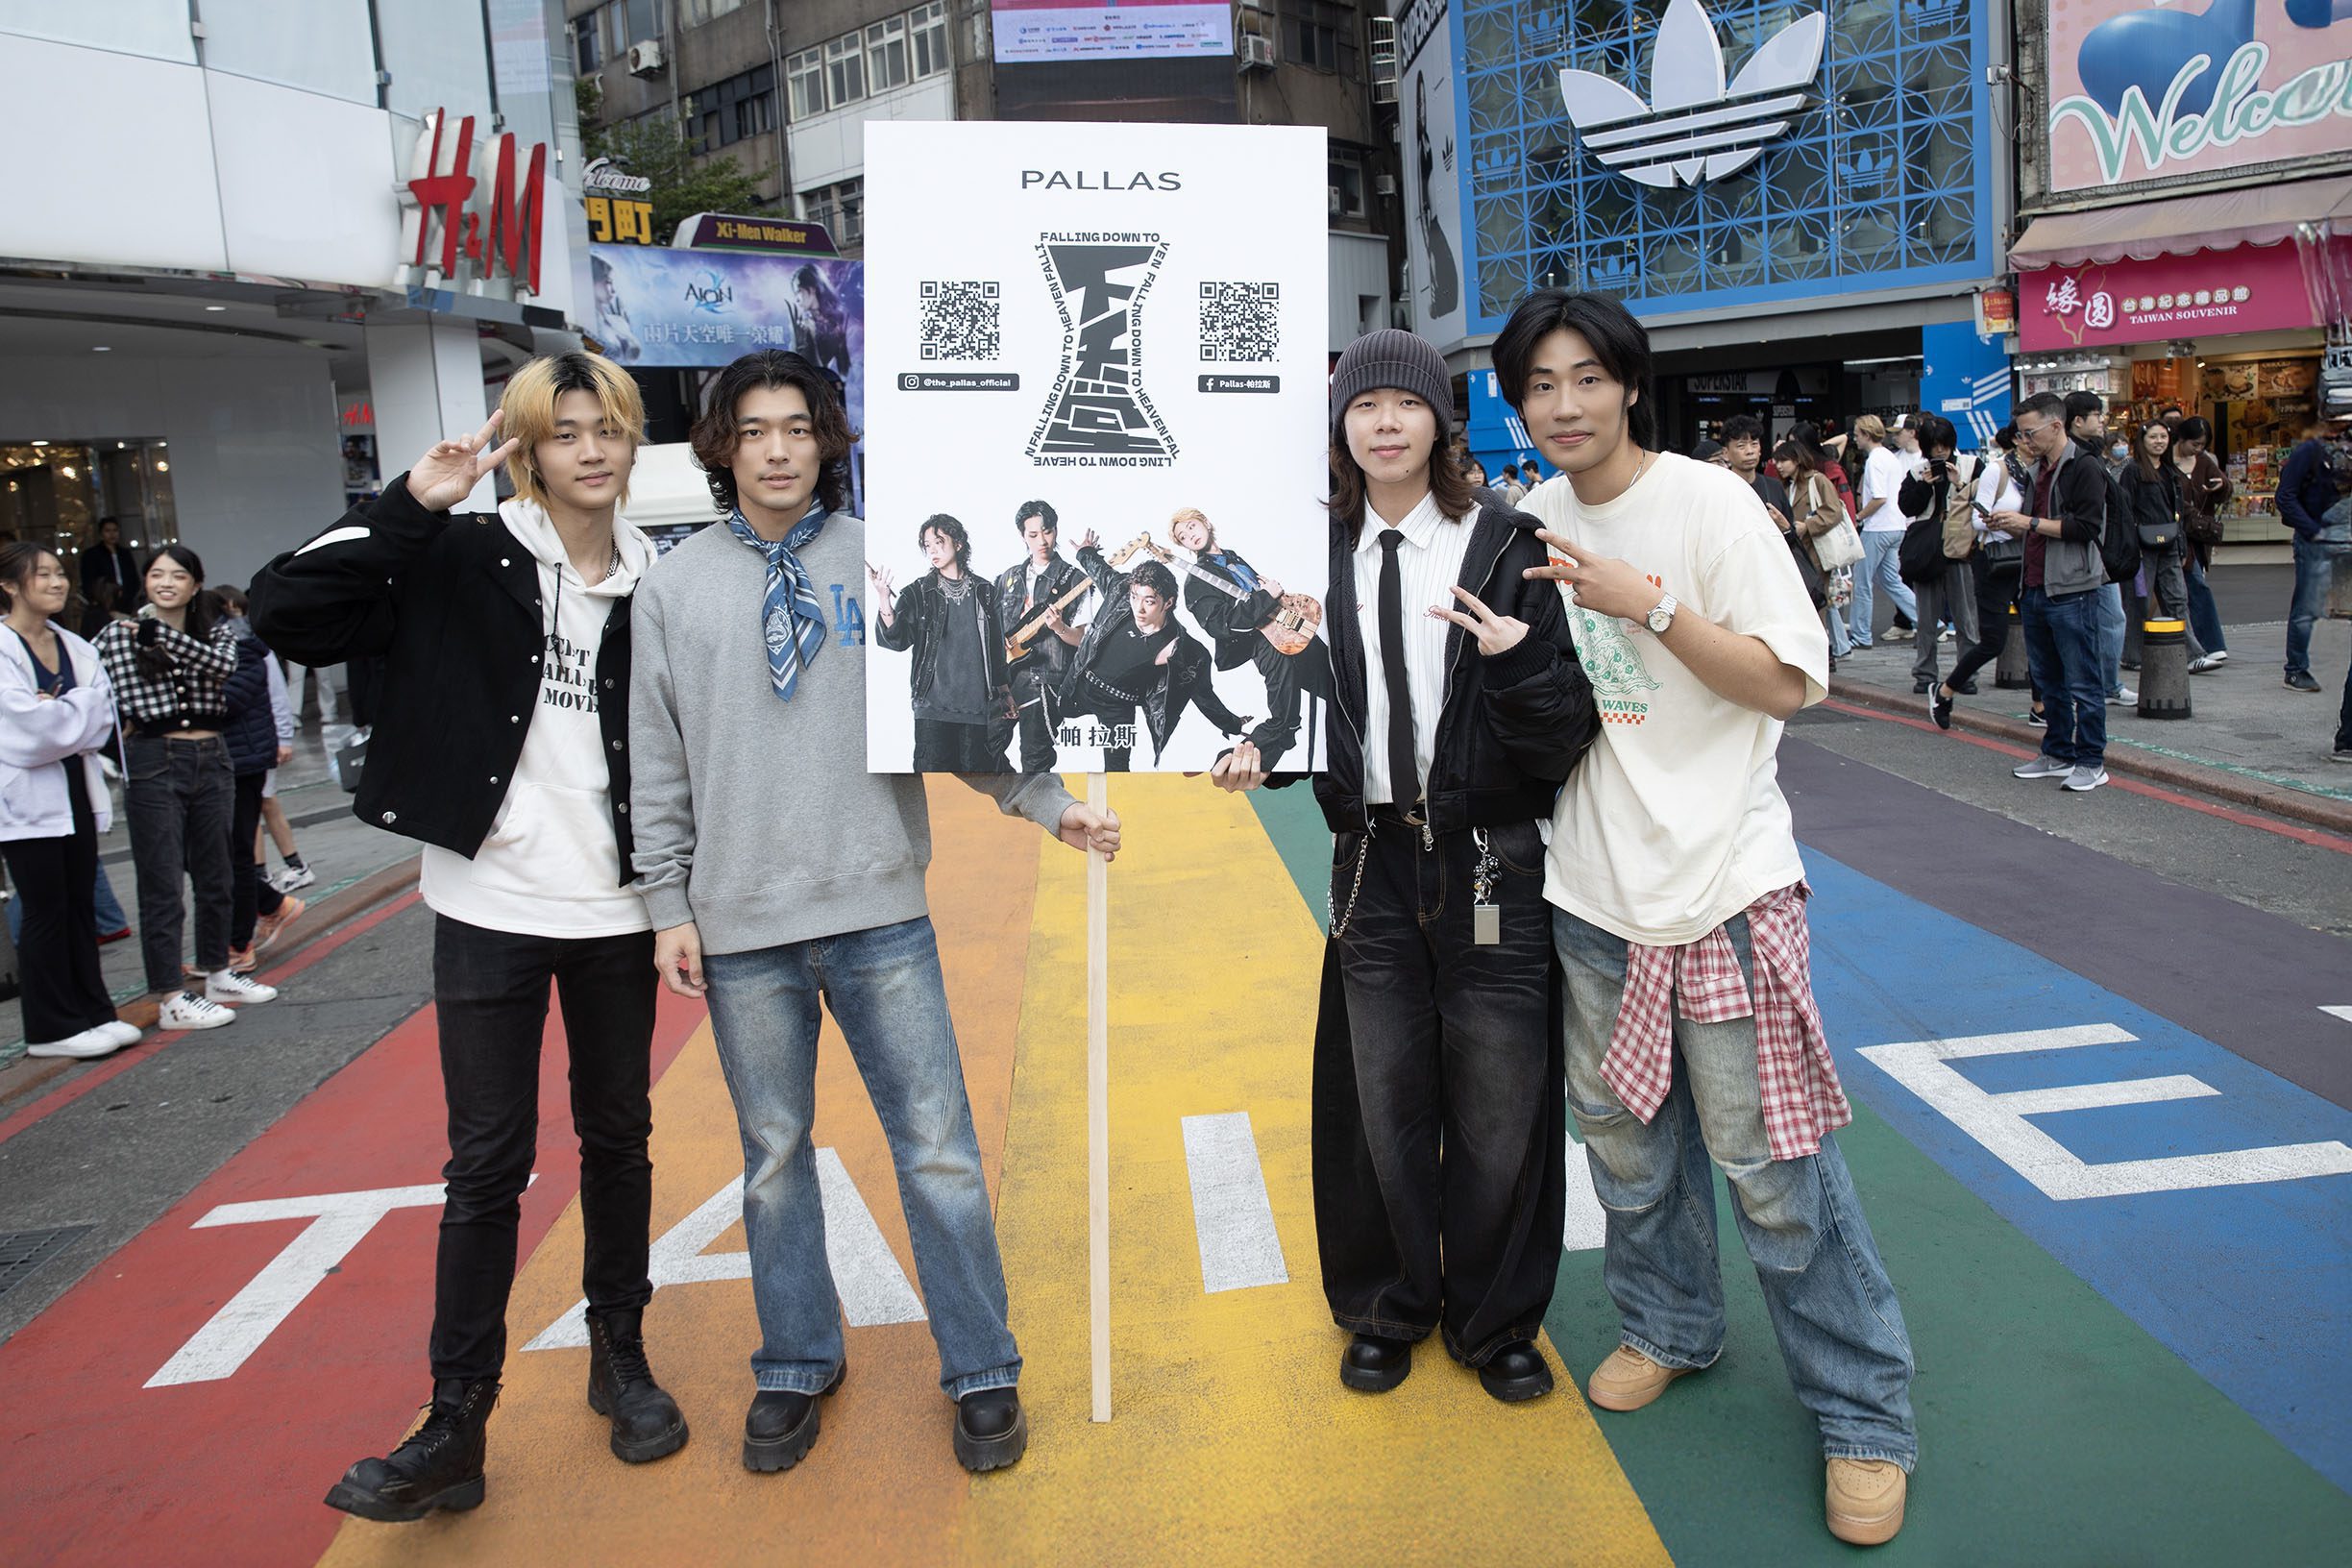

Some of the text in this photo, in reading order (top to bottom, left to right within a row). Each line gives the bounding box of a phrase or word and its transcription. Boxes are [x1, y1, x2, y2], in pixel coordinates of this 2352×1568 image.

[1021, 170, 1182, 191] PALLAS
[408, 107, 545, 296] H&M
[716, 221, 807, 244] Xi-Men Walker
[1041, 232, 1161, 242] FALLING DOWN TO
[1035, 242, 1056, 282] FALLI
[1049, 282, 1075, 333] HEAVEN
[2129, 306, 2238, 325] TAIWAN SOUVENIR
[1063, 334, 1073, 353] TO
[1132, 242, 1181, 460] VEN FALLING DOWN TO HEAVEN FAL
[923, 378, 1012, 388] @the_pallas_official
[1054, 355, 1071, 392] DOWN
[1030, 392, 1060, 449] FALLING
[1860, 404, 1919, 417] SUPERSTAR
[1034, 456, 1172, 467] LING DOWN TO HEAVE
[829, 583, 866, 647] LA
[1602, 699, 1649, 713] WAVES
[1060, 725, 1138, 747] 帕拉斯
